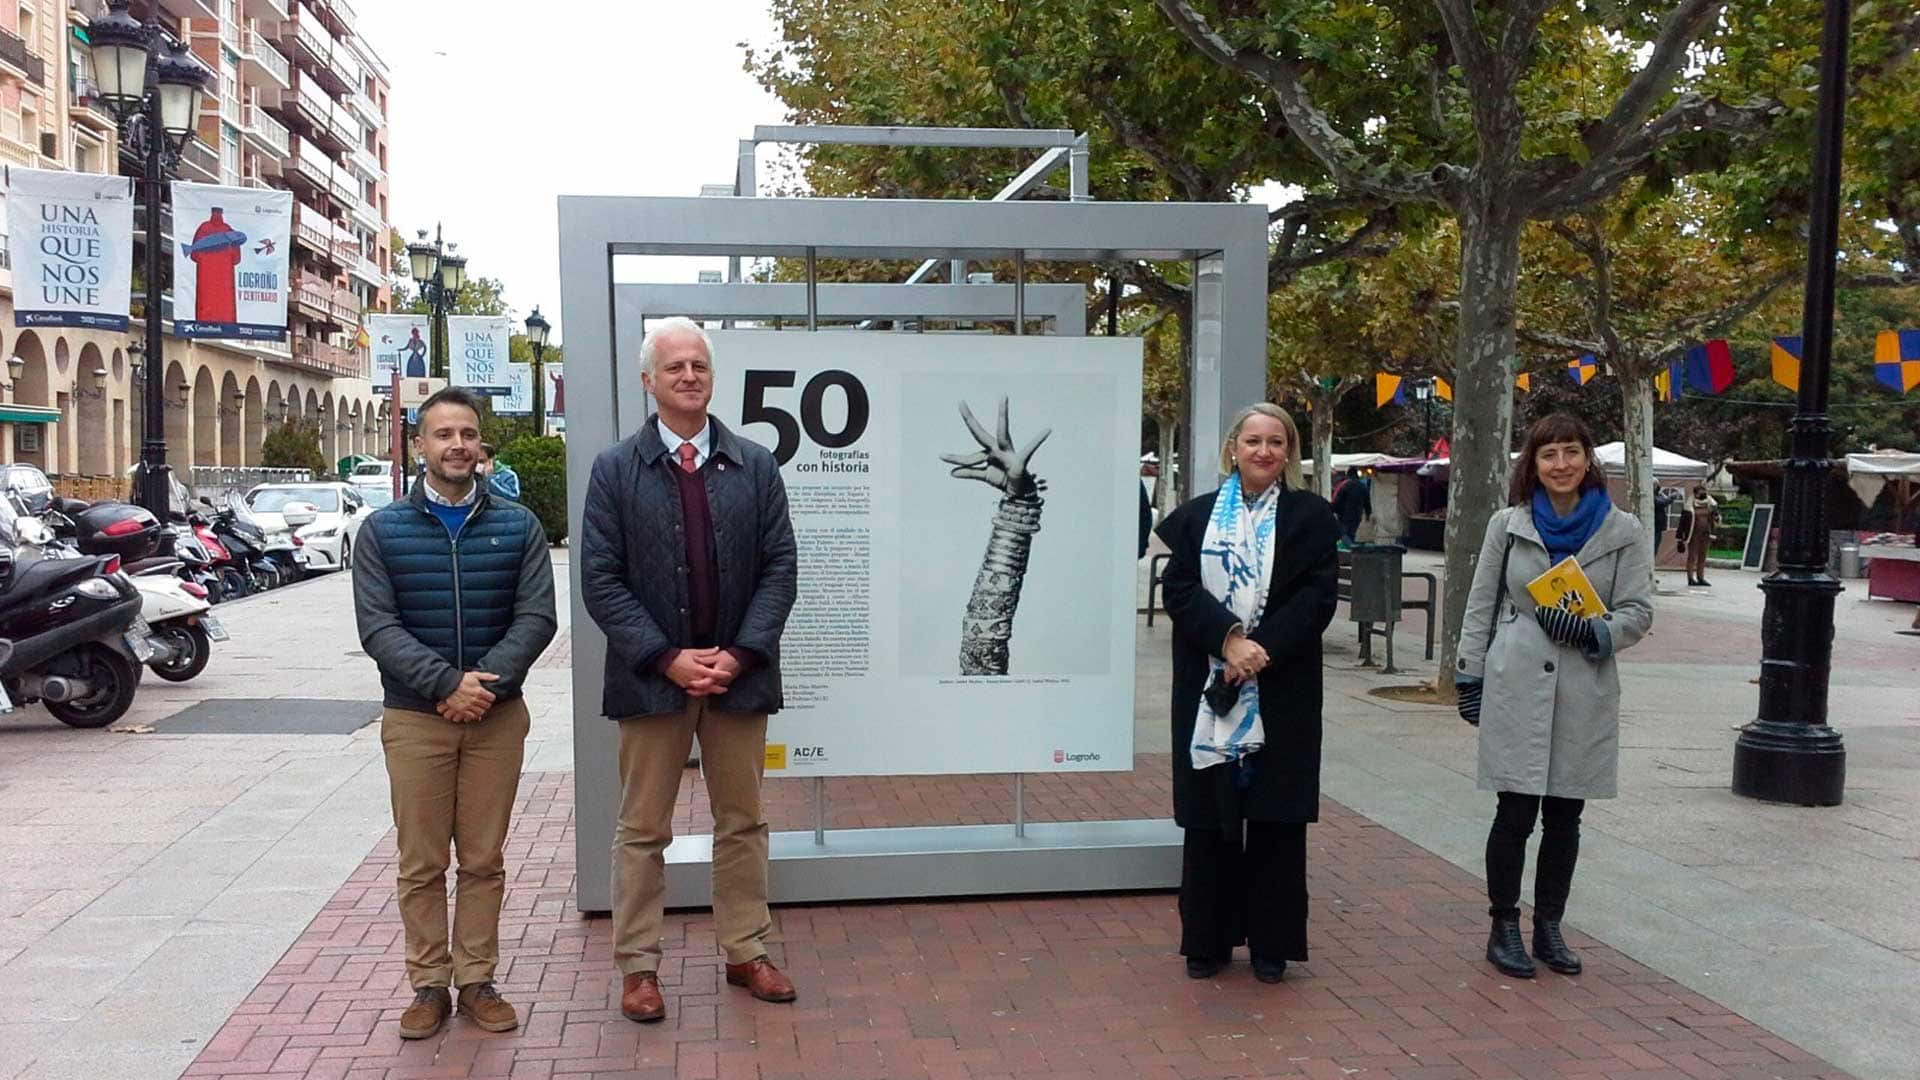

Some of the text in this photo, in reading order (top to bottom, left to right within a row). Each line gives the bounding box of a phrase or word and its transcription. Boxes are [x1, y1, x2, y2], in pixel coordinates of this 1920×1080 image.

[40, 203, 99, 224] UNA
[42, 224, 100, 237] HISTORIA
[40, 235, 100, 264] QUE
[42, 263, 100, 285] NOS
[238, 270, 278, 290] LOGROÑO
[41, 285, 100, 306] UNE
[243, 290, 278, 303] CENTENARIO
[465, 332, 493, 342] UNA
[465, 348, 495, 362] QUE
[466, 362, 494, 373] NOS
[466, 373, 495, 384] UNE
[741, 369, 870, 468] 50
[820, 450, 870, 461] fotografías
[796, 461, 870, 473] con historia
[1066, 752, 1101, 763] Logroño
